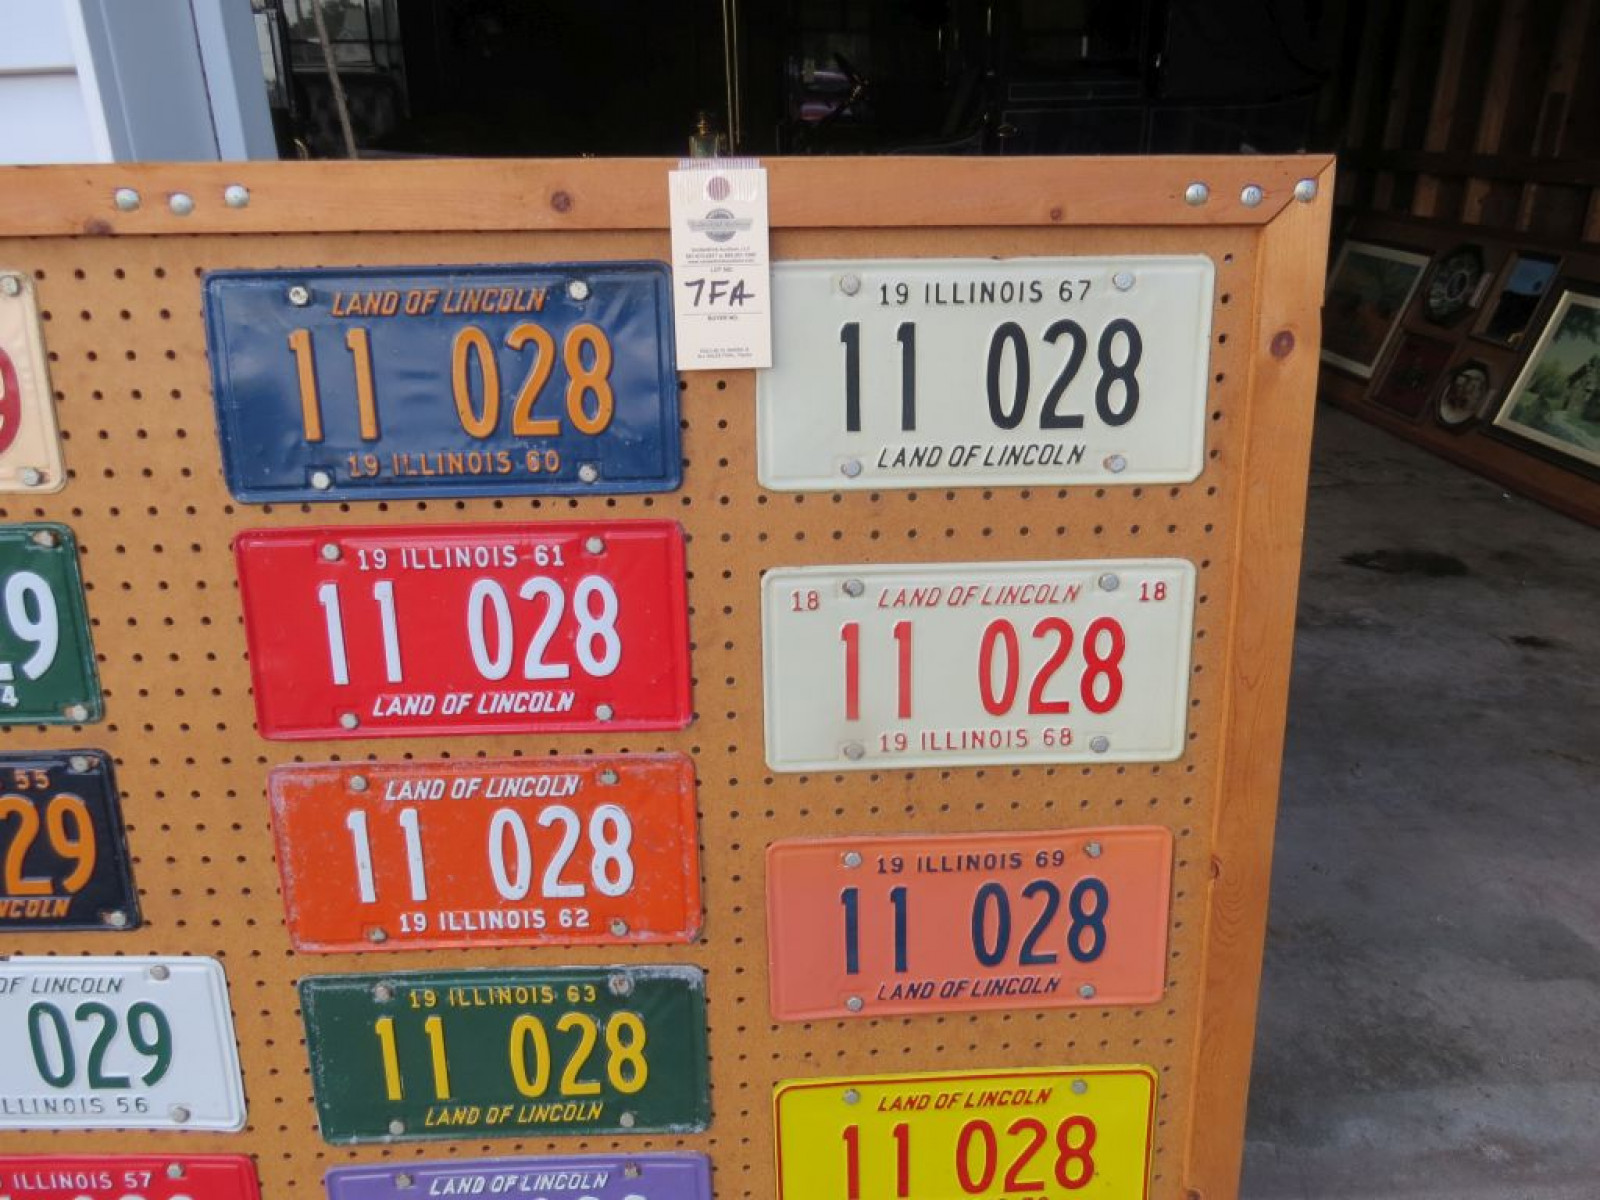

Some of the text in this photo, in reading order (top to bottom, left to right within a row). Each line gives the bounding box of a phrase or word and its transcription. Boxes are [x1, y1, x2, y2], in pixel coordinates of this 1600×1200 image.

[331, 286, 549, 317] LAND OF LINCOLN
[684, 278, 755, 307] 7FA
[880, 280, 1092, 307] 19 ILLINOIS 67
[288, 322, 615, 442] 11 028
[840, 317, 1143, 432] 11 028
[348, 452, 561, 478] 19 ILLINOIS 60
[878, 443, 1087, 469] LAND OF LINCOLN
[357, 545, 564, 570] 19 ILLINOIS 61
[791, 591, 820, 612] 18
[878, 584, 1082, 609] LAND OF LINCOLN
[1138, 582, 1168, 603] 18
[317, 574, 621, 686] 11 028
[840, 616, 1126, 721] 11 028
[372, 691, 575, 717] LAND OF LINCOLN
[879, 727, 1074, 752] 19 ILLINOIS 68
[14, 769, 50, 790] 55
[384, 775, 581, 801] LAND OF LINCOLN
[346, 804, 635, 904] 11 028
[876, 850, 1065, 875] 19 ILLINOIS 69
[400, 909, 590, 933] 19 ILLINOIS 62
[840, 877, 1109, 975] 11 028
[31, 977, 126, 994] LINCOLN
[409, 985, 597, 1008] 19 ILLINOIS 63
[876, 976, 1062, 1002] LAND OF LINCOLN
[28, 1001, 173, 1089] 029
[374, 1011, 649, 1101] 11 028
[116, 1097, 149, 1114] 56
[878, 1088, 1054, 1112] LAND OF LINCOLN
[425, 1102, 602, 1126] LAND OF LINCOLN
[842, 1115, 1097, 1200] 11 028
[13, 1172, 152, 1190] ILLINOIS 57
[429, 1172, 609, 1195] LAND OF LINCOLN
